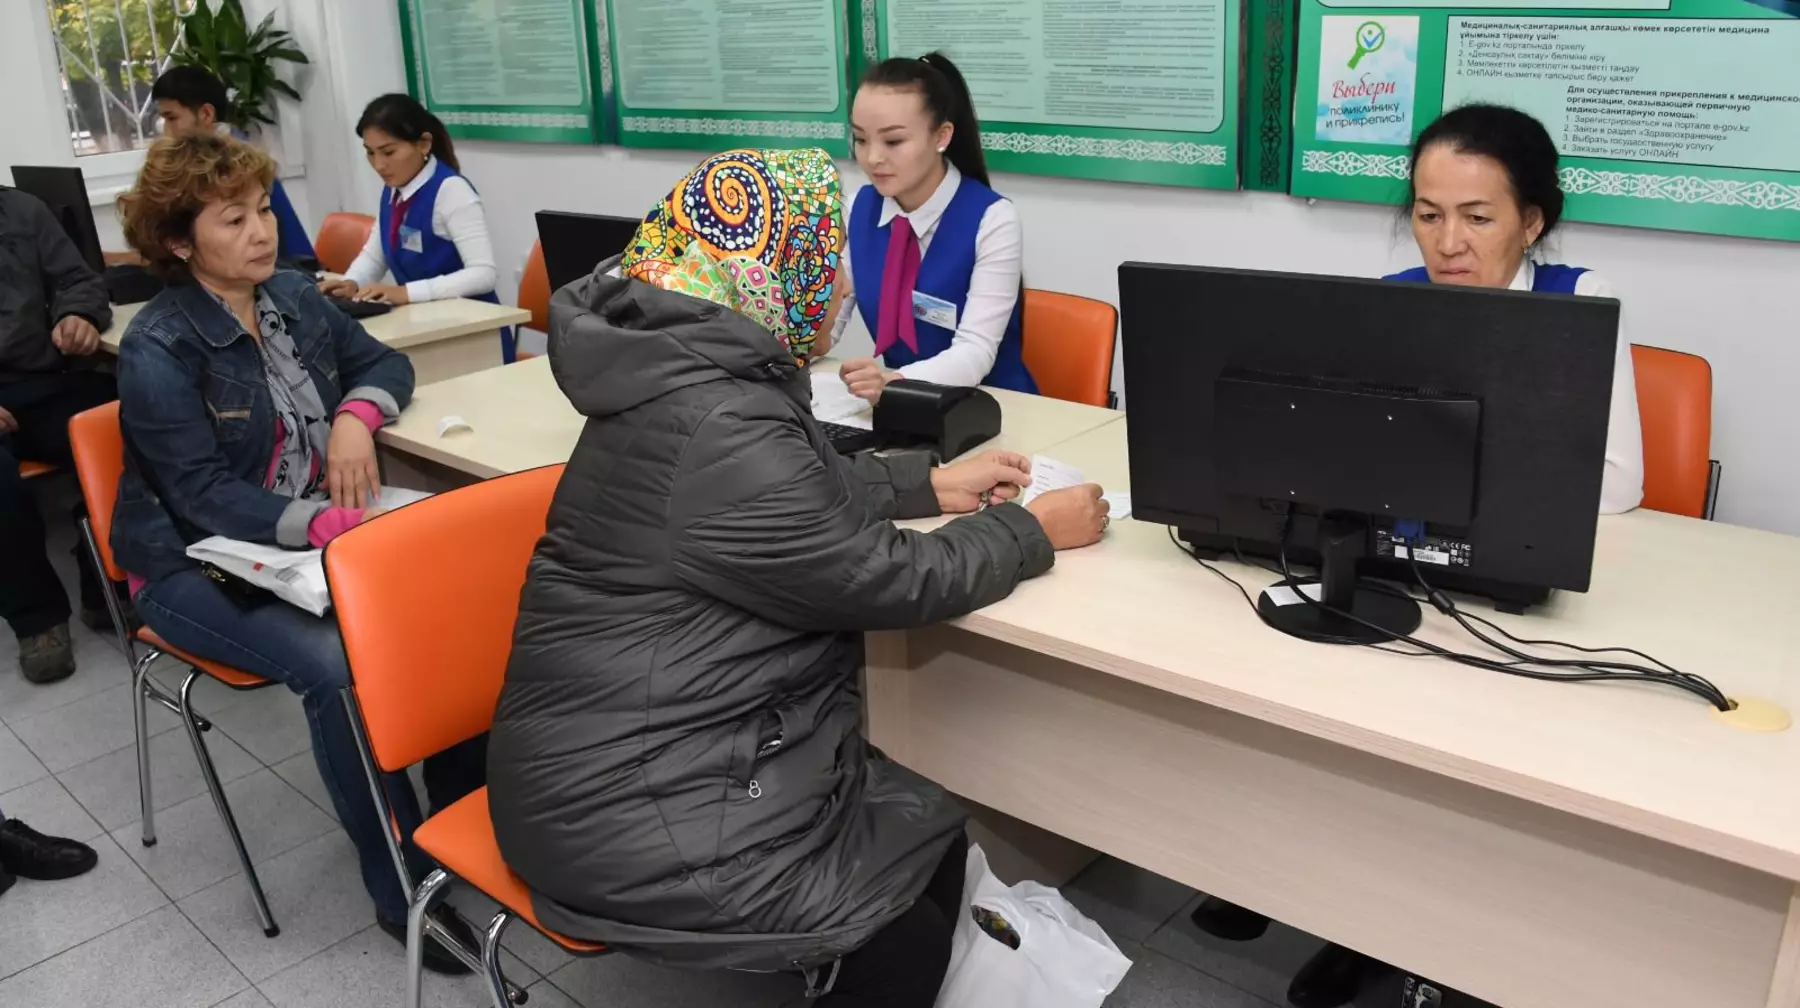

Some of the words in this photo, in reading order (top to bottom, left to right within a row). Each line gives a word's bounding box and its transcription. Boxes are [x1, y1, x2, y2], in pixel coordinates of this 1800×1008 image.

[1502, 33, 1533, 41] тіркелу
[1536, 33, 1560, 41] үшін:
[1590, 24, 1630, 33] алғашқы
[1664, 24, 1716, 34] көрсететін
[1718, 26, 1770, 35] медицина
[1466, 69, 1503, 77] ОНЛАЙН
[1332, 72, 1396, 104] Выбери
[1567, 85, 1584, 94] Для
[1587, 87, 1657, 97] осуществления
[1660, 90, 1727, 100] прикрепления
[1330, 102, 1400, 116] поликлинику
[1566, 96, 1625, 106] организации,
[1627, 99, 1693, 108] оказывающей
[1696, 101, 1751, 112] первичную
[1566, 106, 1655, 117] медико-санитарную
[1335, 112, 1405, 128] прикрепись!
[1574, 115, 1659, 126] Зарегистрироваться
[1675, 122, 1711, 130] портале
[1713, 124, 1750, 133] e-gov.kz
[1607, 128, 1636, 137] раздел
[1572, 134, 1608, 143] Выбрать
[1610, 138, 1683, 149] государственную
[1685, 143, 1715, 152] услугу
[1571, 144, 1608, 153] Заказать
[1610, 148, 1637, 156] услугу
[1639, 148, 1679, 159] ОНЛАЙН
